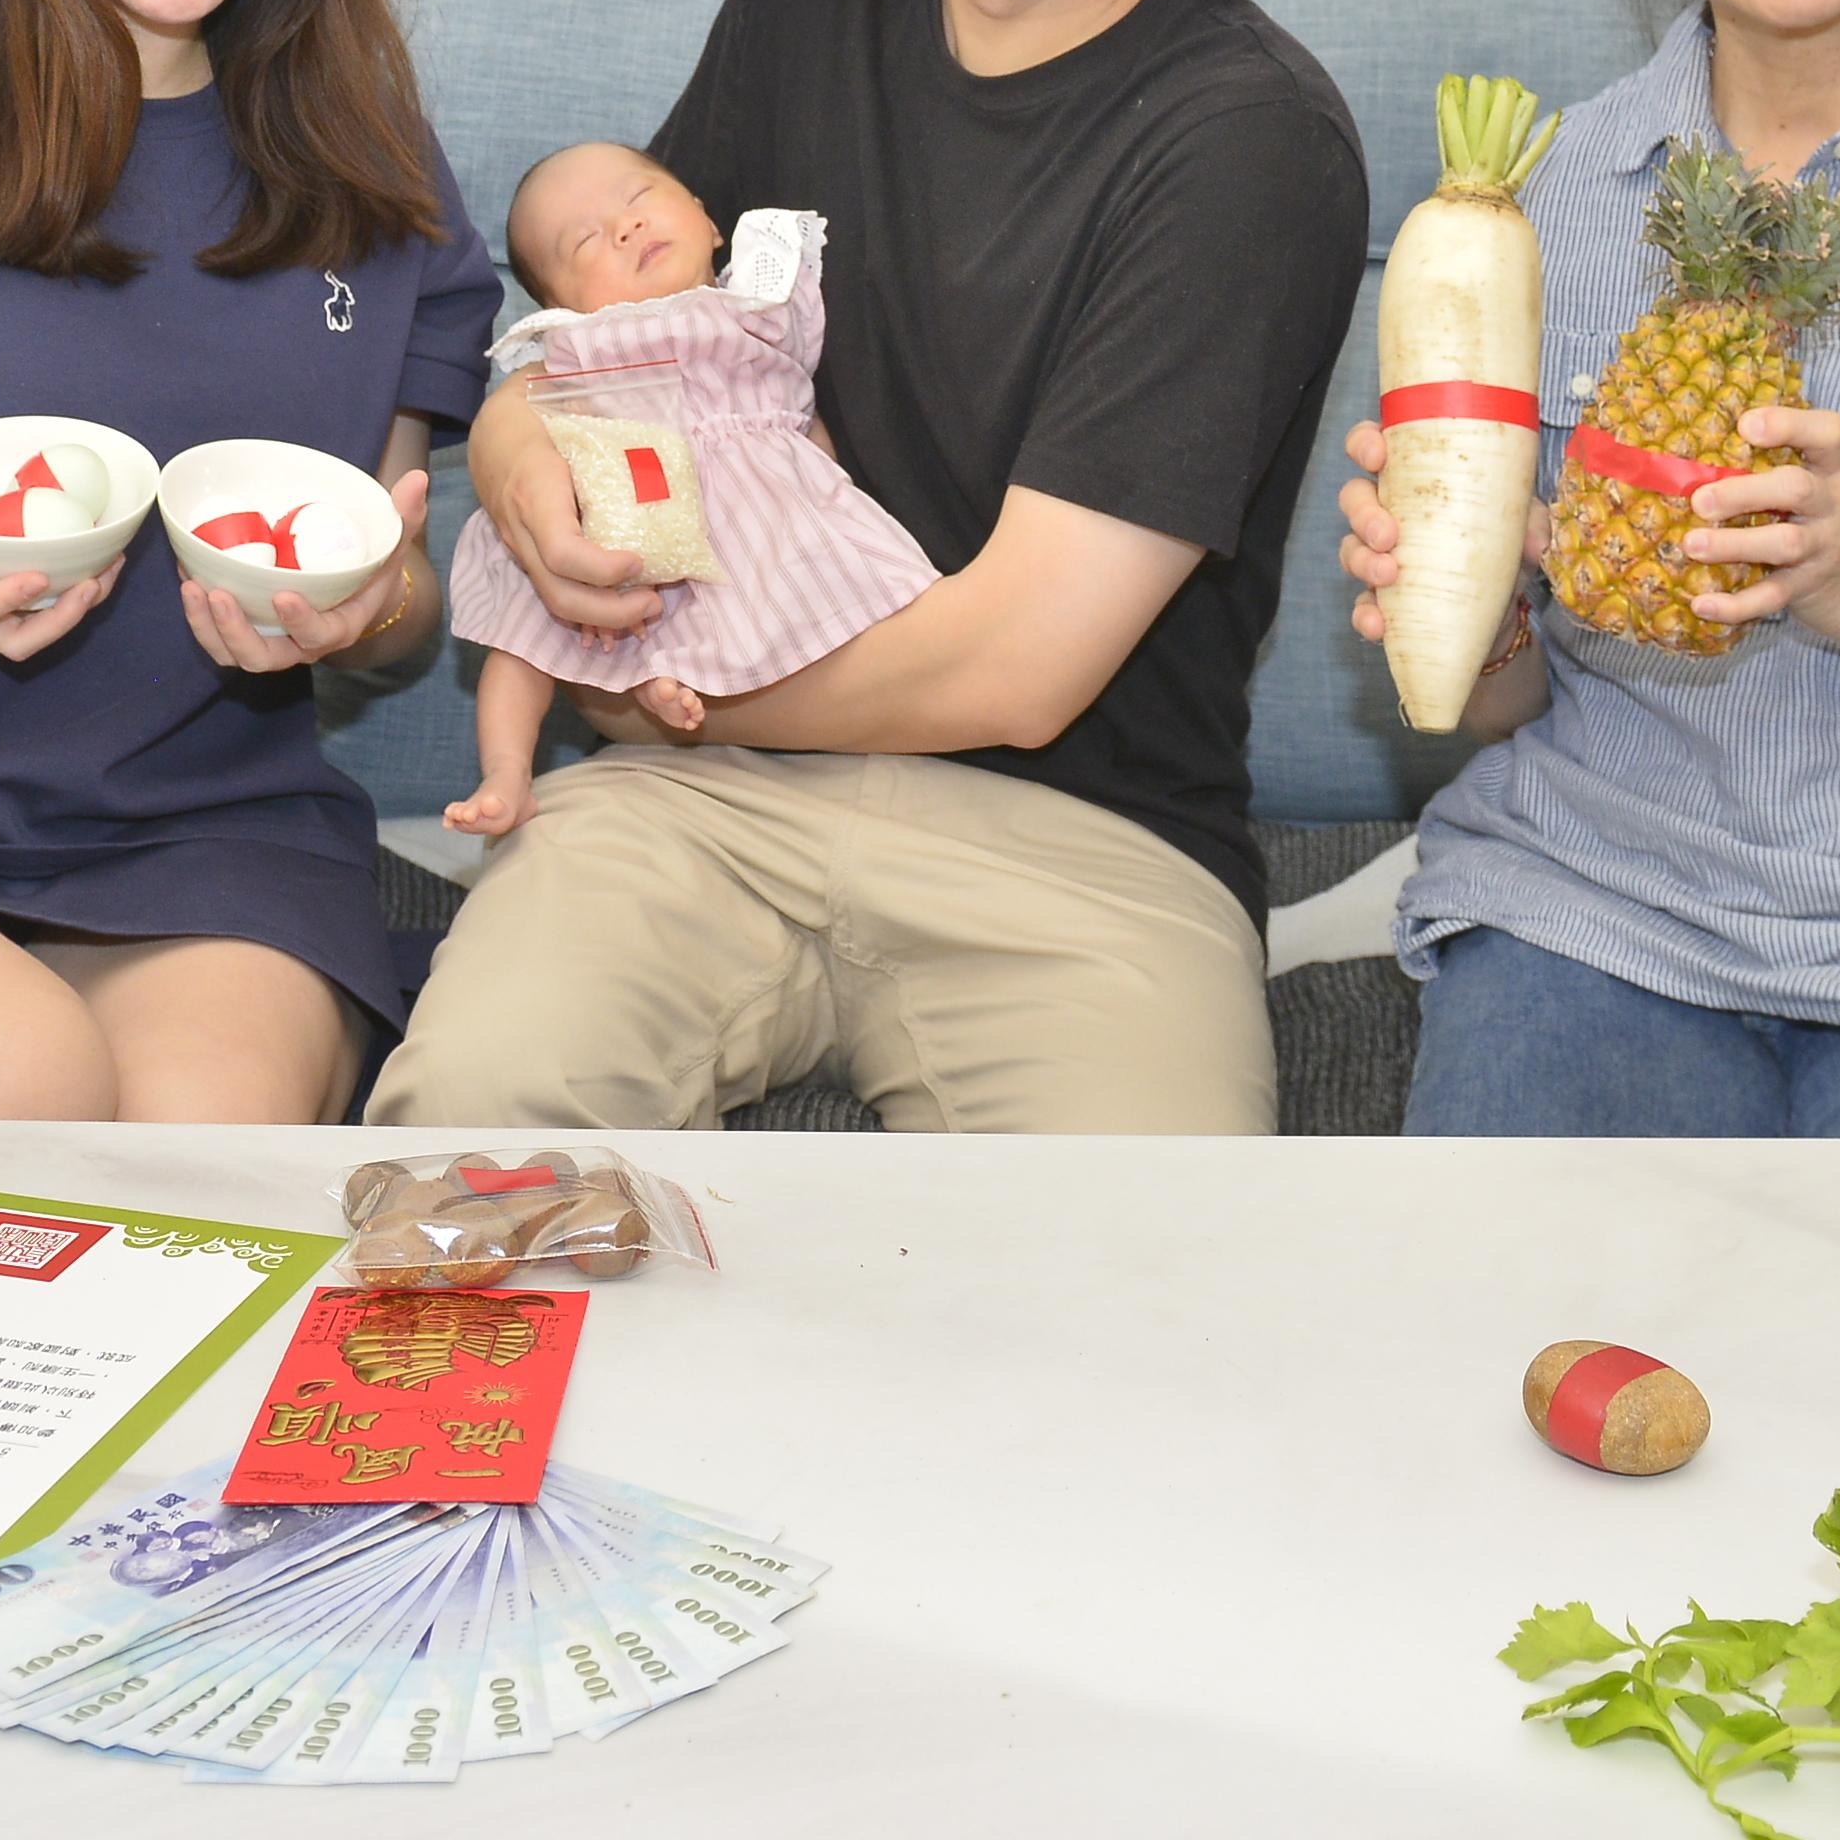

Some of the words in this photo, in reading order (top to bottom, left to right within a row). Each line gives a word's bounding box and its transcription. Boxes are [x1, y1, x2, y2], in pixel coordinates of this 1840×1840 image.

[690, 1563, 778, 1598] 1000
[675, 1598, 756, 1646] 1000
[8, 1633, 104, 1678] 1000
[566, 1644, 616, 1703] 1000
[615, 1631, 678, 1685] 1000
[61, 1676, 149, 1726] 1000
[226, 1698, 292, 1751] 1000
[489, 1677, 522, 1740] 1000
[296, 1702, 351, 1762] 1000
[404, 1708, 440, 1766] 1000
